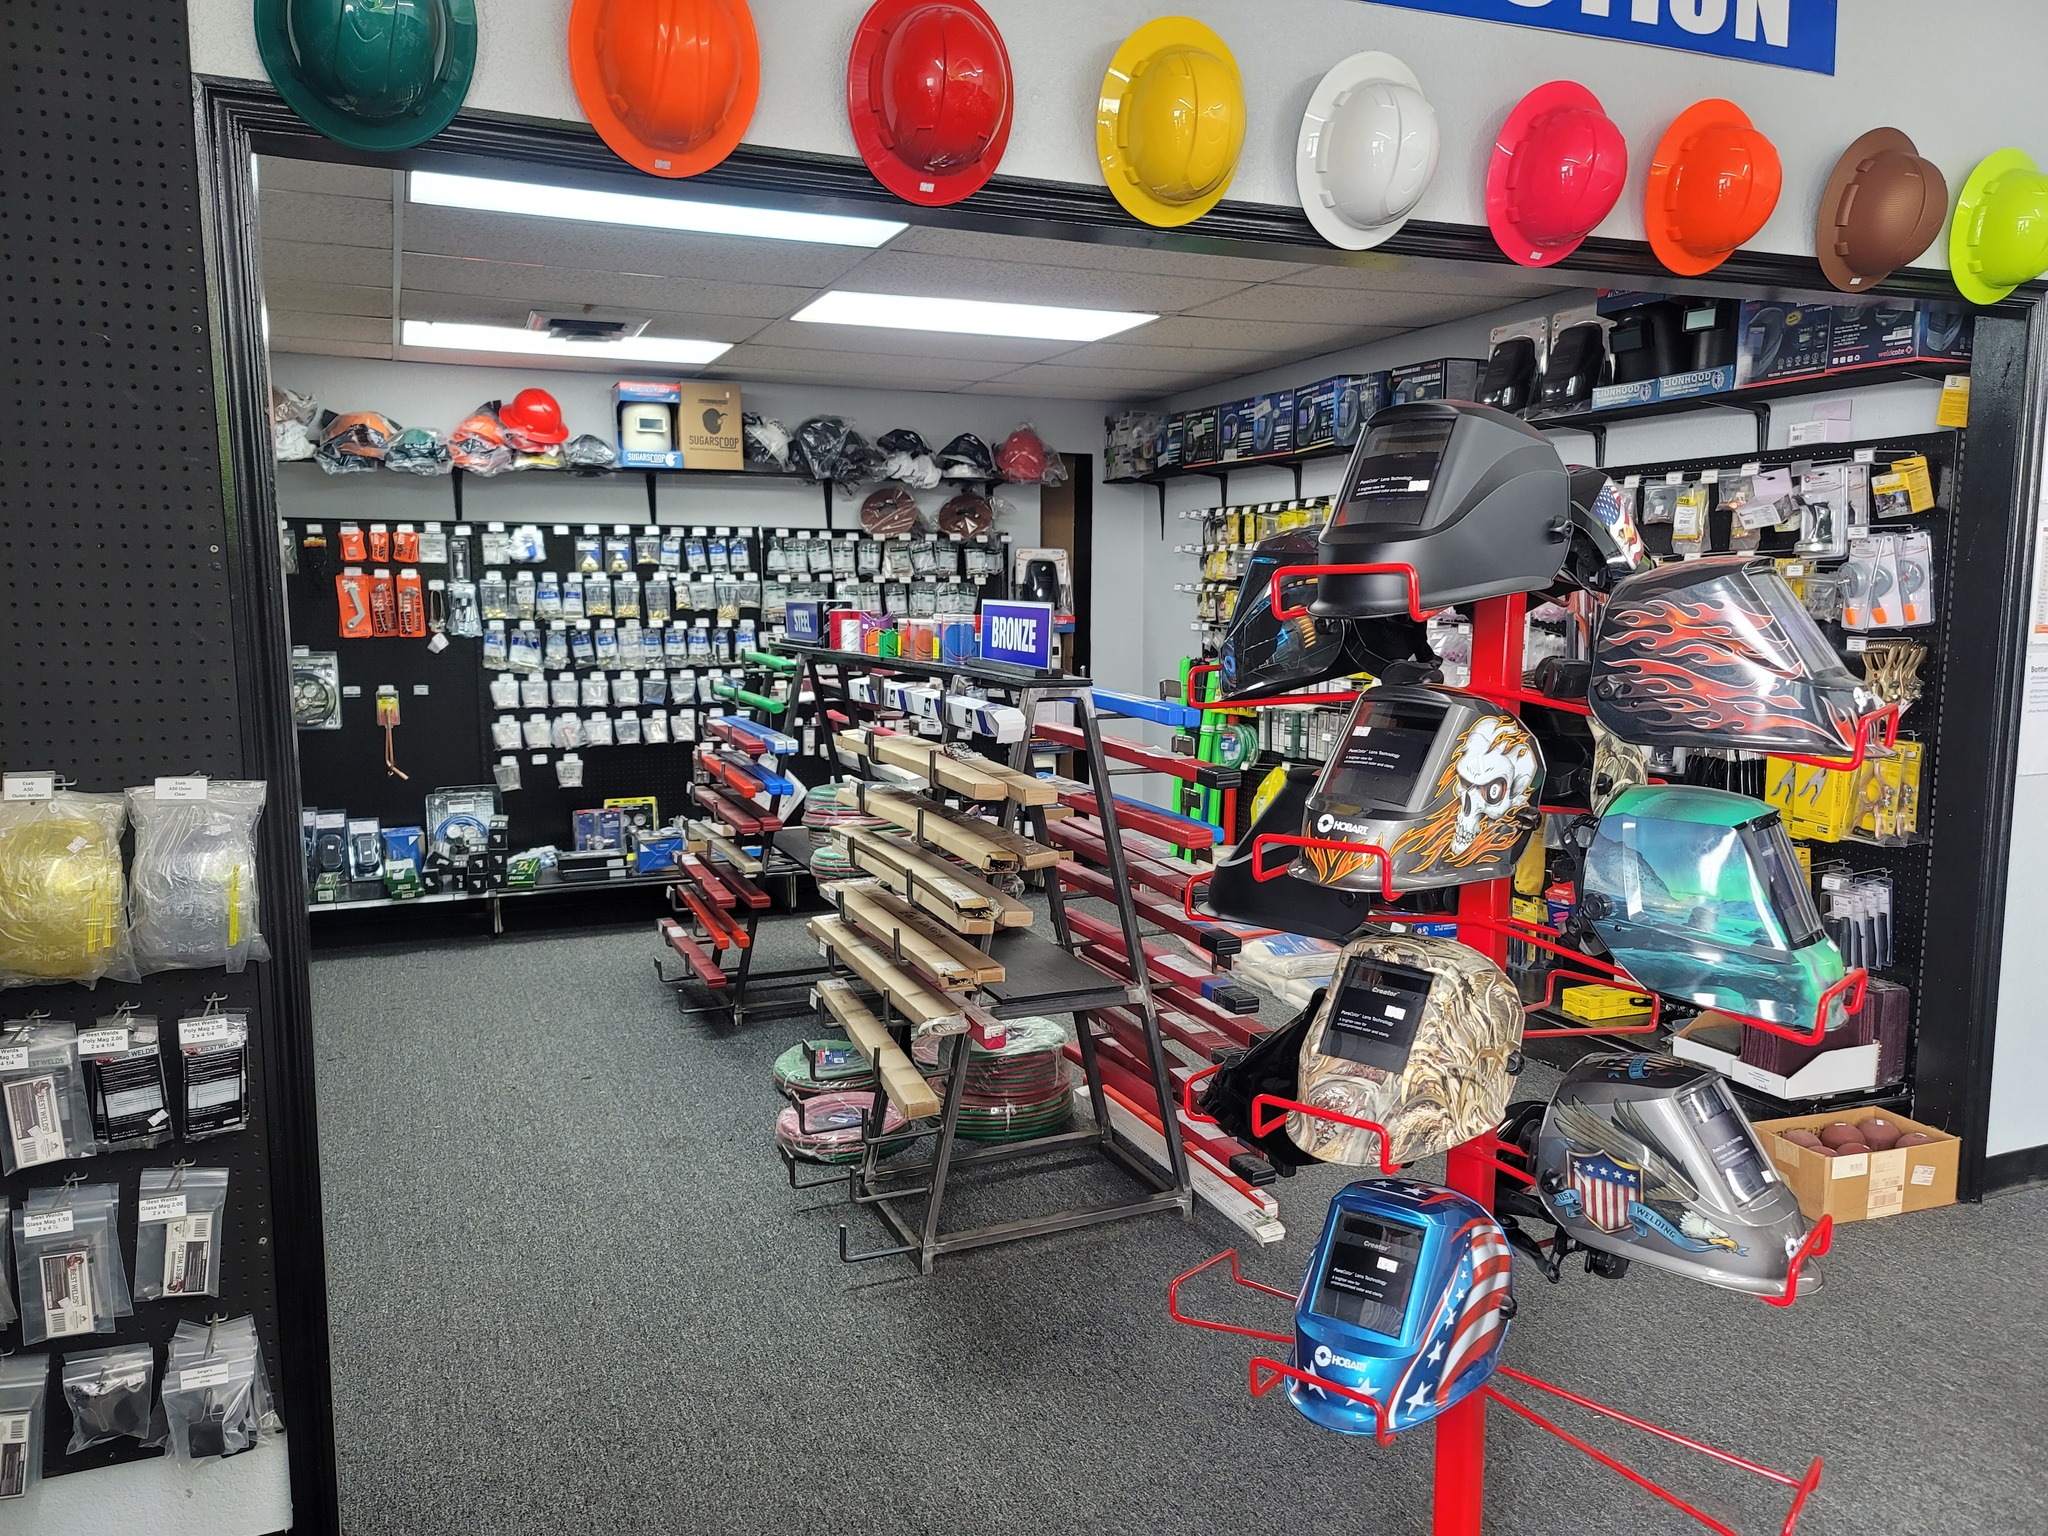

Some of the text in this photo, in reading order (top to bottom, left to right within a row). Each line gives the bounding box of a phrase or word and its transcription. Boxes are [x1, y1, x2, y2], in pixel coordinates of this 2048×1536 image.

[1663, 372, 1711, 387] LIONHOOD
[1596, 385, 1640, 398] LIONHOOD
[689, 436, 739, 449] SUGARSCOOP
[627, 453, 665, 463] SUGARSCOOP
[793, 609, 811, 633] STEEL
[992, 616, 1037, 653] BRONZE
[1491, 786, 1498, 797] 8
[1333, 820, 1369, 835] HOBART
[1371, 986, 1397, 997] Creator
[131, 1048, 155, 1057] WELDS
[42, 1057, 64, 1066] WELDS
[38, 1094, 49, 1132] BEST WELDS
[1558, 1191, 1574, 1201] USA
[1636, 1206, 1676, 1239] WELDING
[1363, 1240, 1388, 1251] Creator
[177, 1244, 185, 1264] WELDS
[69, 1268, 80, 1304] BEST WELDS
[1331, 1354, 1367, 1373] HOBART
